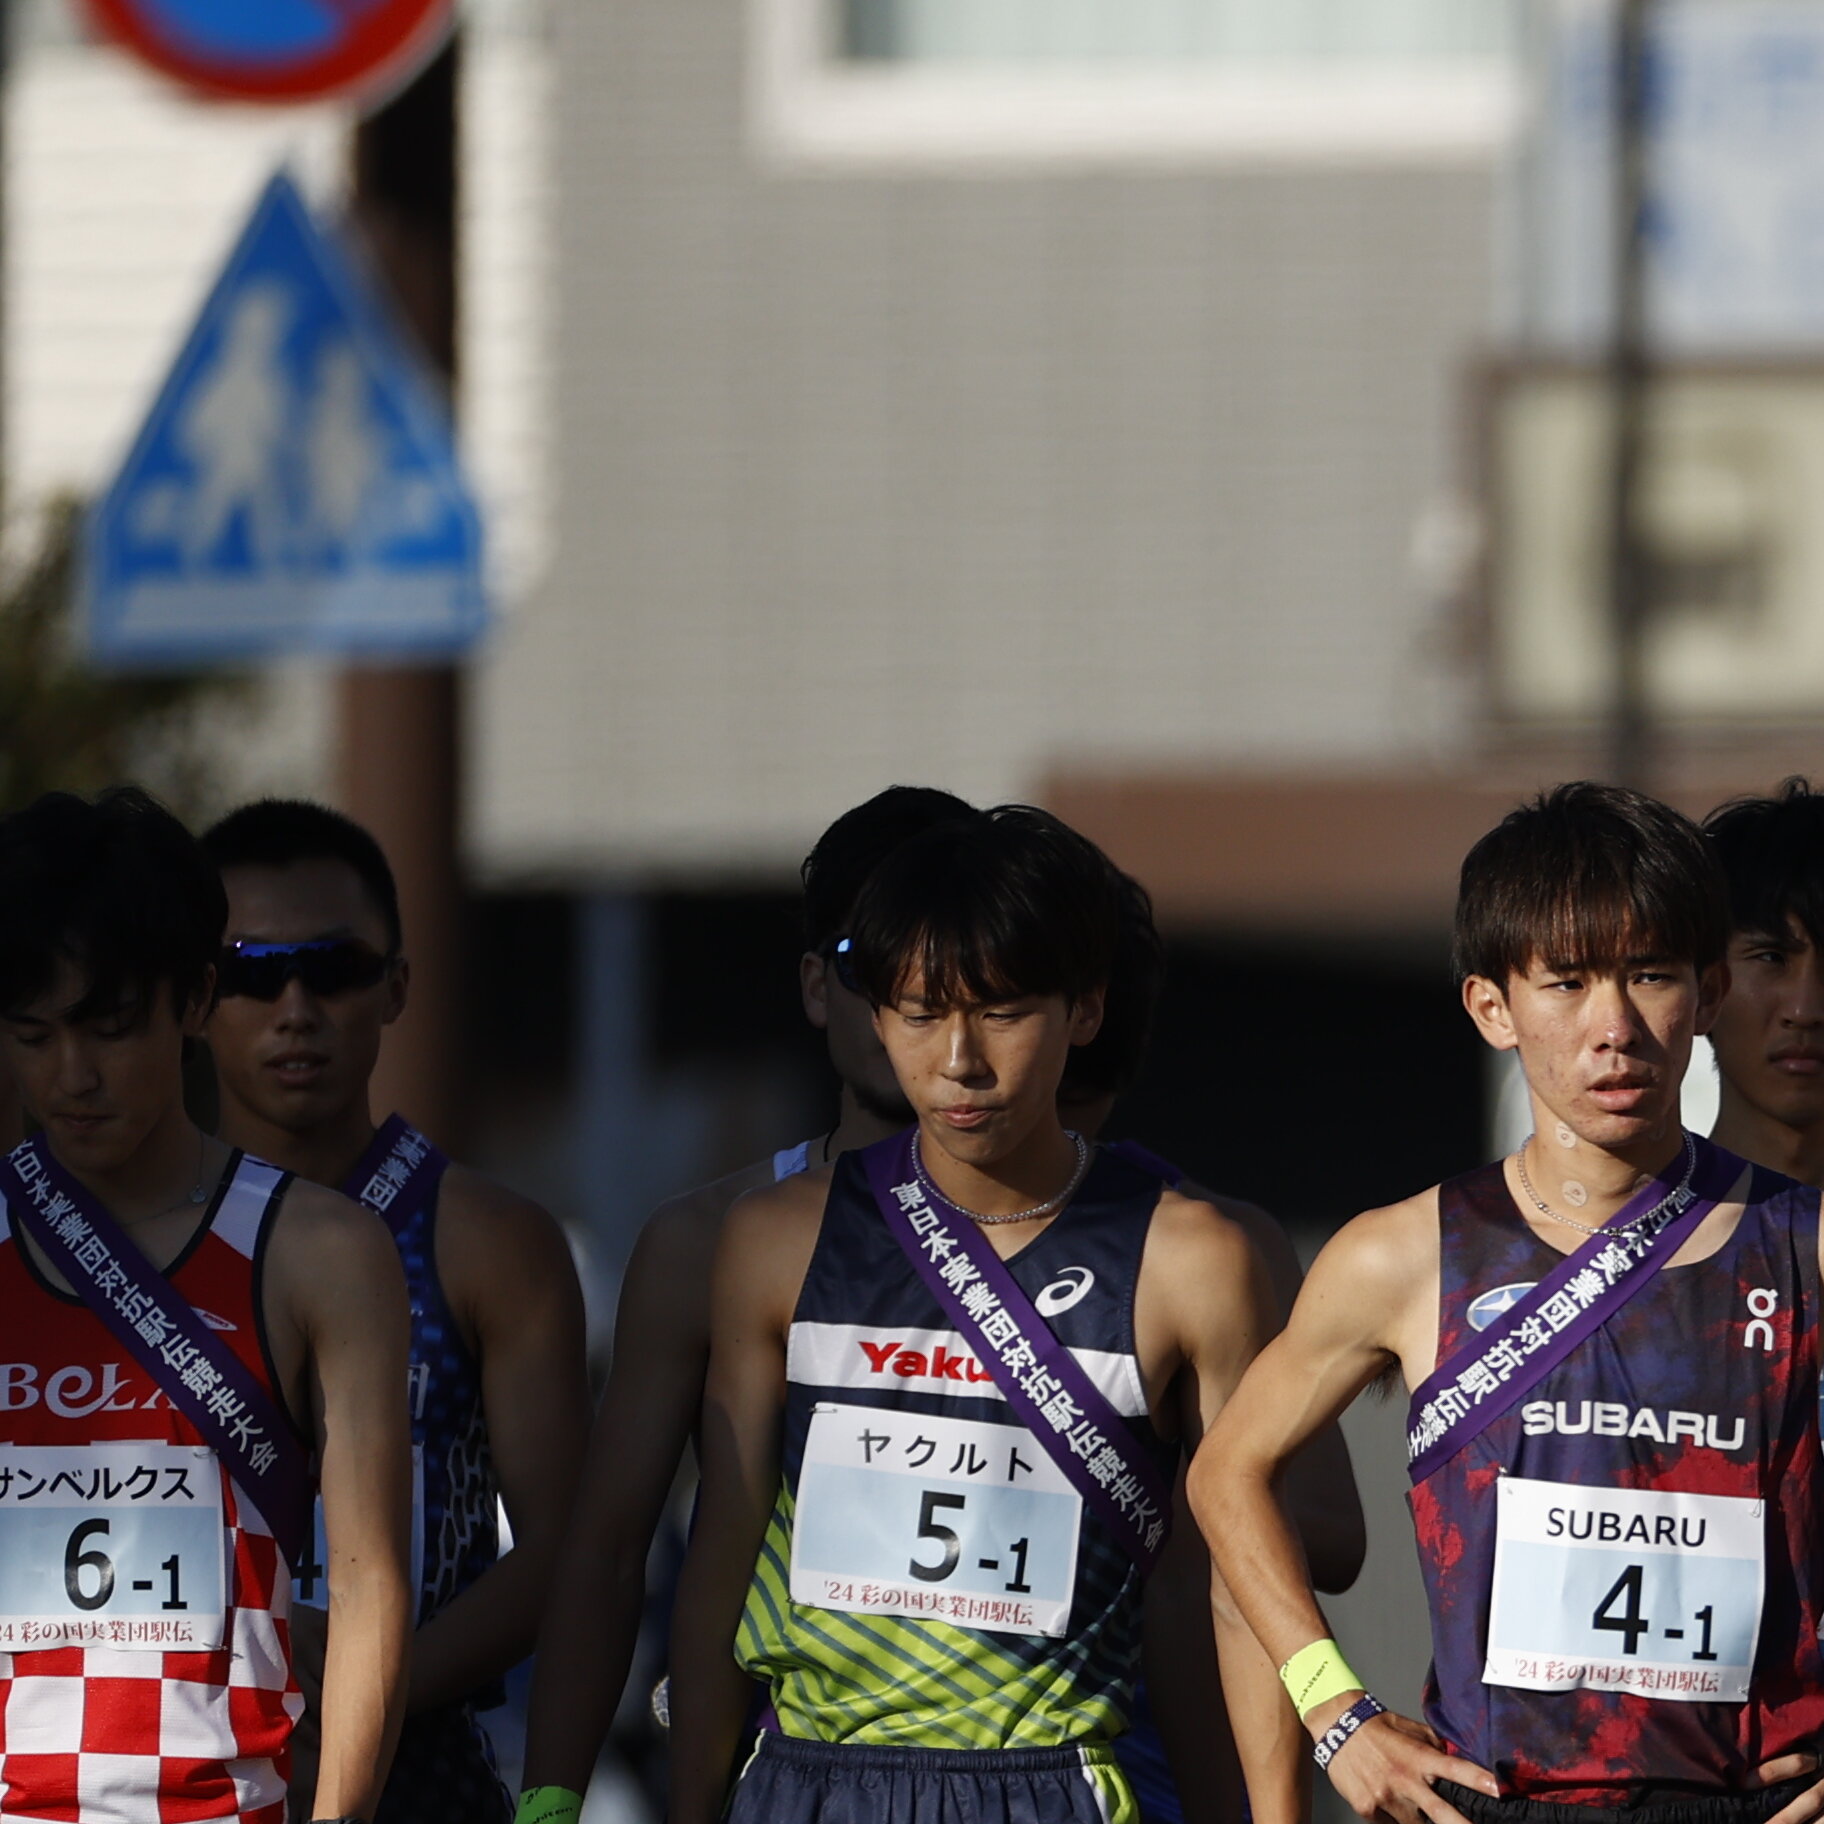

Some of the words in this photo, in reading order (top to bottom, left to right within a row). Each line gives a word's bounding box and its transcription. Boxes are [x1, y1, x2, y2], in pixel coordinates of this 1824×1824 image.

[890, 1179, 1167, 1553] 東日本実業団対抗駅伝競走大会
[1521, 1400, 1745, 1450] SUBARU
[857, 1428, 1032, 1482] ヤクルト
[909, 1490, 1031, 1594] 5-1
[1547, 1508, 1706, 1547] SUBARU
[65, 1518, 188, 1611] 6-1
[824, 1580, 853, 1601] '24
[861, 1585, 1033, 1626] 彩の国実業団駅伝
[1592, 1564, 1718, 1661] 4-1
[20, 1621, 193, 1644] 彩の国実業団駅伝
[1515, 1658, 1538, 1679] '24
[1544, 1661, 1719, 1693] 彩の国実業団駅伝
